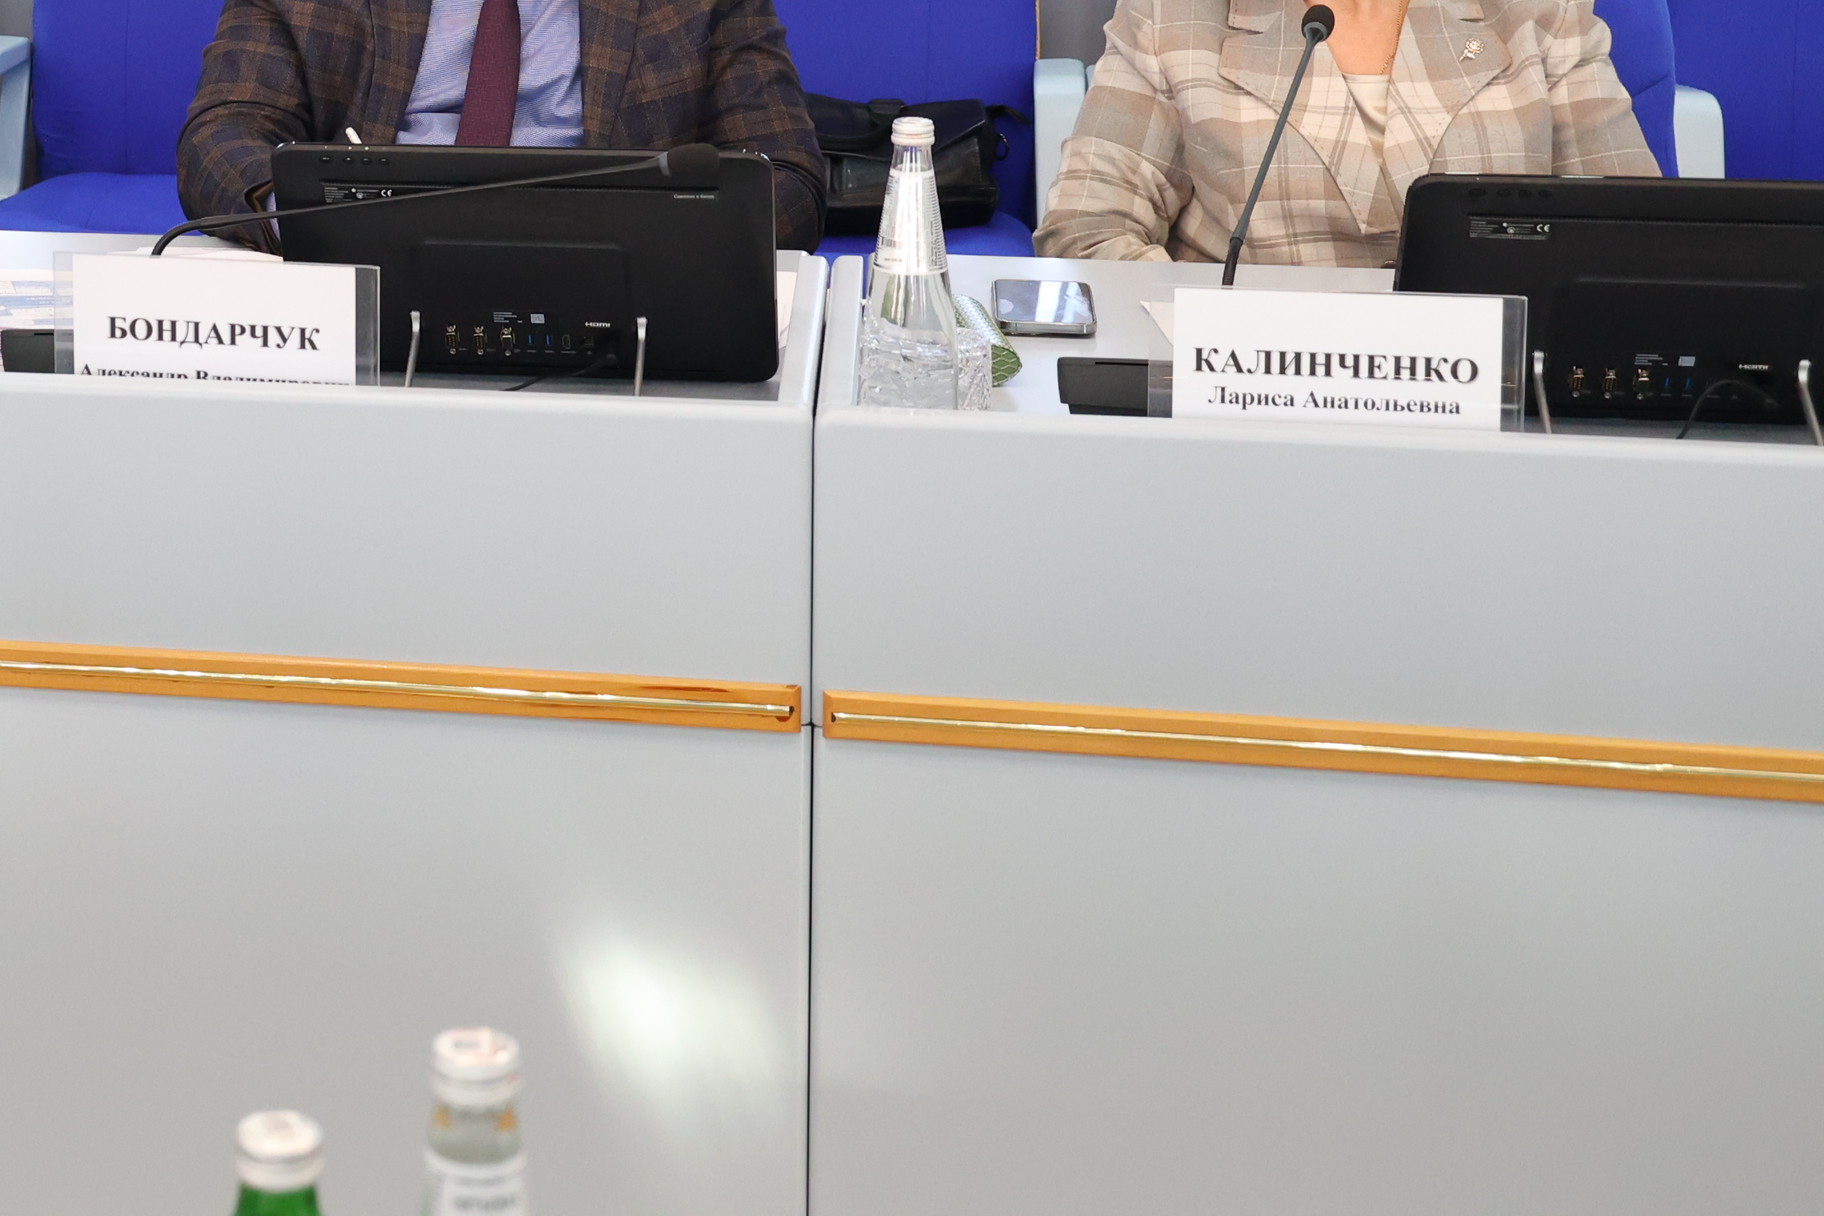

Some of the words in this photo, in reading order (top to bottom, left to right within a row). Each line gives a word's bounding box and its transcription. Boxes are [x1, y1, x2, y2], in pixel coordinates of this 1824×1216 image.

[107, 315, 321, 351] БОНДАРЧУК
[1192, 346, 1480, 385] КАЛИНЧЕНКО
[1208, 386, 1295, 411] Лариса
[1302, 390, 1462, 416] Анатольевна
